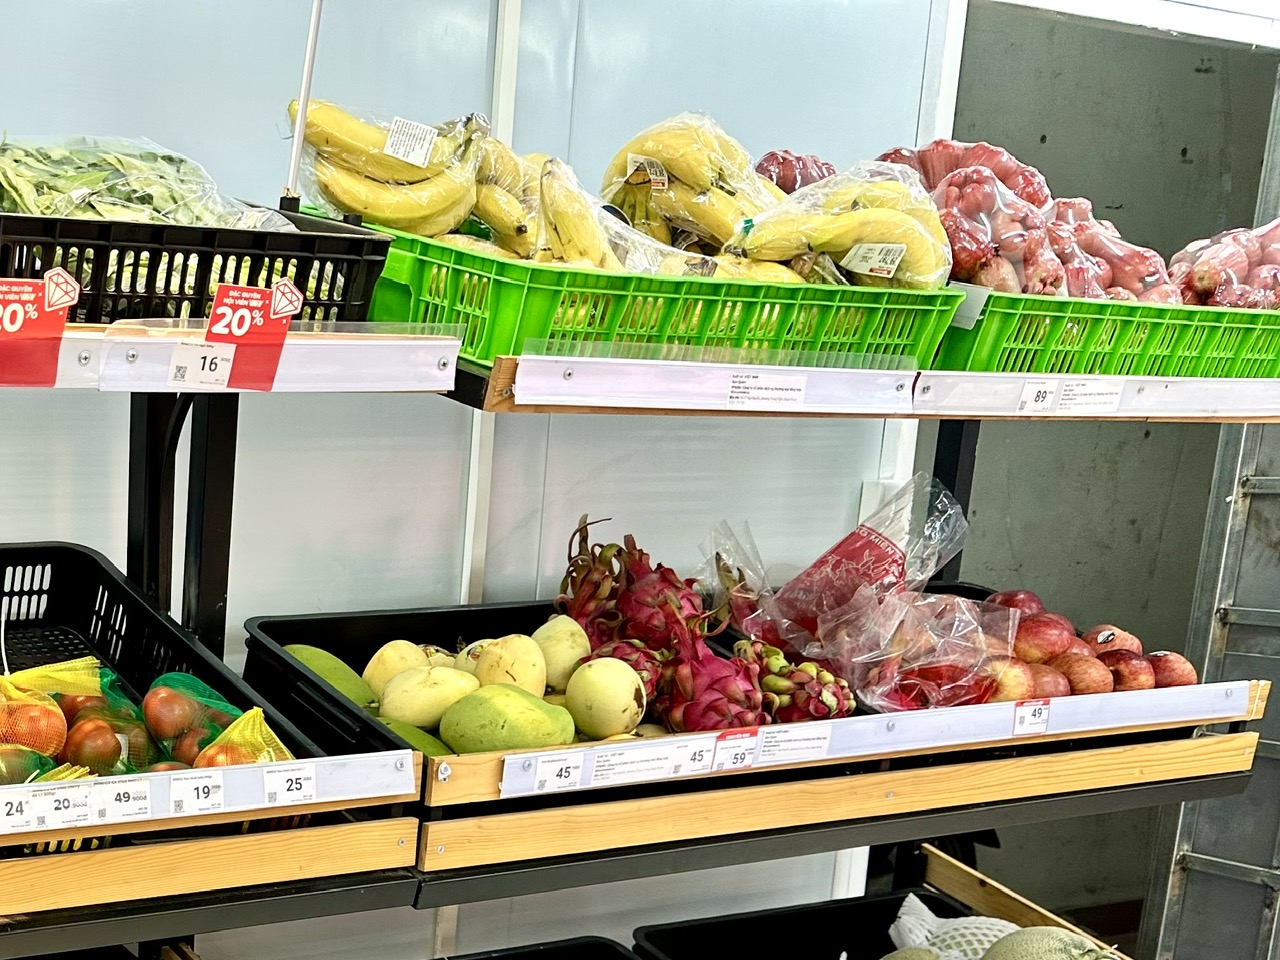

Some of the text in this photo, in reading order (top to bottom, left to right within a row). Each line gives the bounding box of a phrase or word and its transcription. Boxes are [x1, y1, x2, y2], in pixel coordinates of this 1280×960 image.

[211, 306, 264, 337] 20%
[200, 355, 218, 372] 16
[1034, 390, 1048, 402] 89
[1031, 707, 1042, 719] 49
[690, 750, 704, 763] 45
[732, 752, 746, 765] 59
[556, 766, 571, 779] 45
[286, 778, 302, 791] 25
[115, 792, 131, 803] 49
[194, 785, 210, 800] 19
[4, 801, 24, 816] 24
[54, 798, 70, 811] 20
